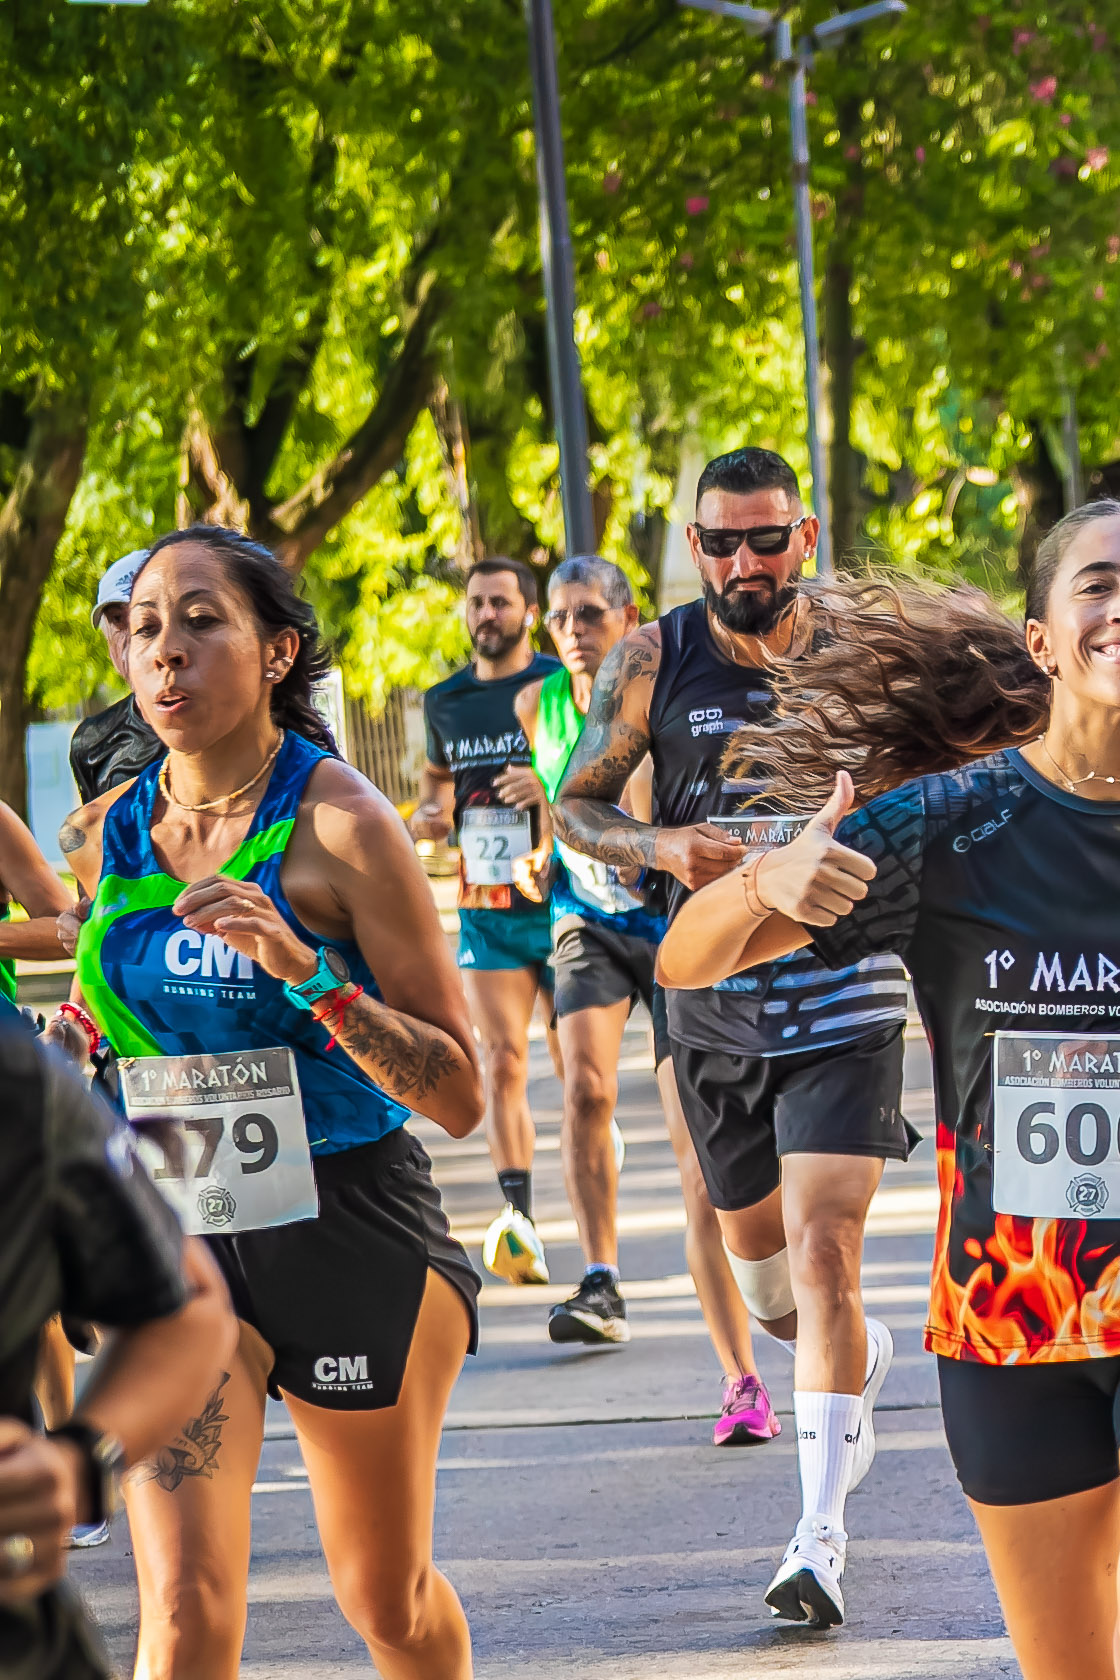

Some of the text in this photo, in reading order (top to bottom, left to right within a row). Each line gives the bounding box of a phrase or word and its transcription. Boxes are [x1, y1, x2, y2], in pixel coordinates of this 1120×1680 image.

[691, 720, 724, 738] graph
[458, 729, 528, 759] MARATÓ
[745, 822, 804, 844] MARATÓ
[475, 835, 511, 860] 22
[164, 929, 254, 979] CM
[221, 990, 257, 999] TEAM
[1038, 1003, 1106, 1016] BOMBEROS
[161, 1057, 269, 1091] MARATÓN
[1078, 1185, 1097, 1201] 27
[314, 1355, 369, 1382] CM
